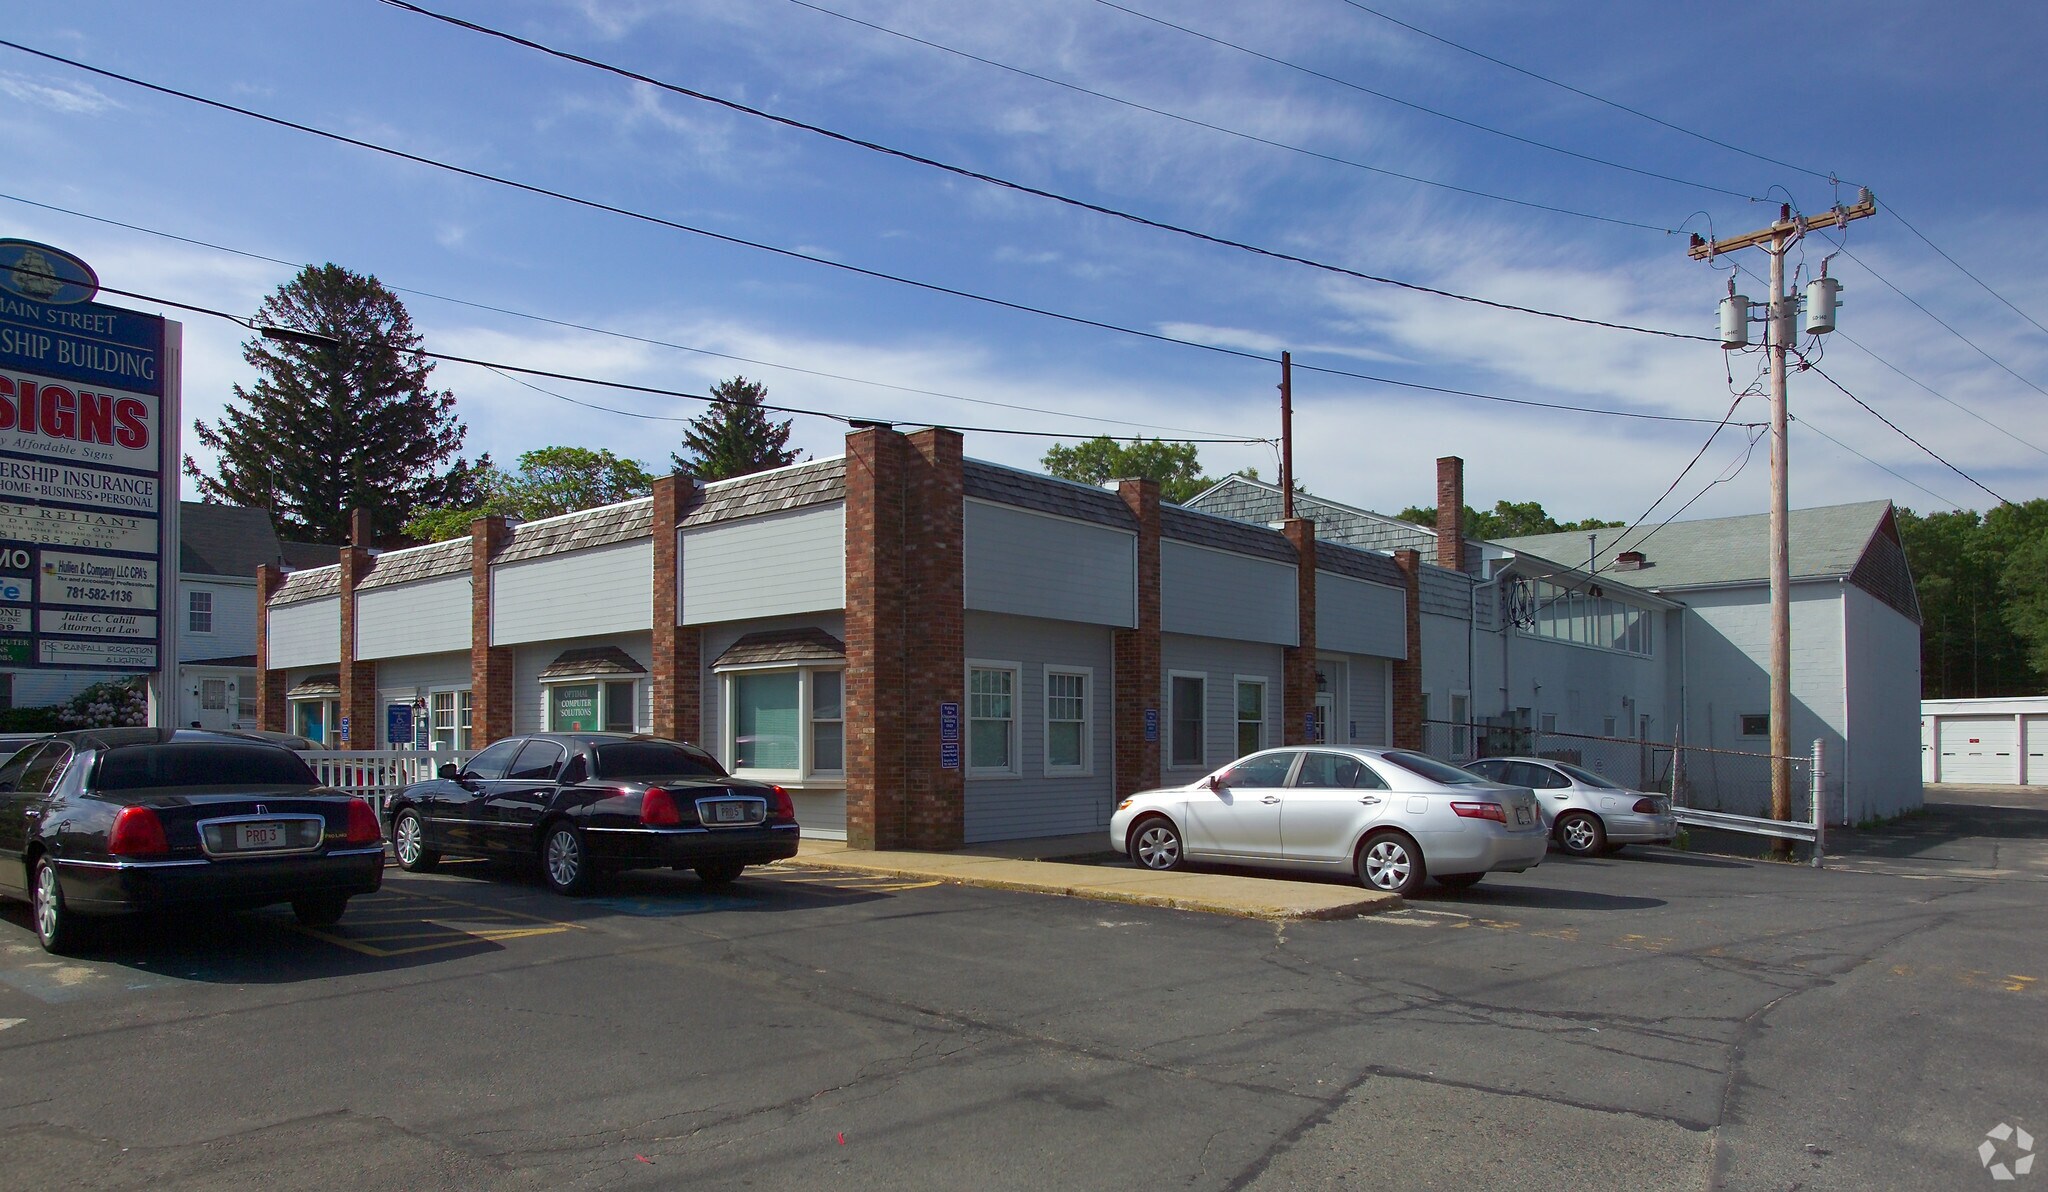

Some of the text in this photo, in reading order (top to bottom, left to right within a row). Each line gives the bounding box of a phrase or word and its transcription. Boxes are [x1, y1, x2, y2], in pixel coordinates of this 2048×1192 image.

[0, 298, 117, 335] AIN STREET
[58, 340, 154, 380] BUILDING
[13, 437, 77, 455] Affordable
[82, 447, 114, 461] Signs
[64, 470, 153, 495] INSURANCE
[41, 484, 93, 500] BUSINESS
[100, 492, 153, 508] PERSONAL
[40, 509, 140, 528] RELIANT
[80, 562, 85, 574] &
[86, 563, 115, 580] Company
[117, 565, 129, 578] LLC
[130, 566, 147, 580] CPA's
[81, 578, 115, 586] Accounting
[116, 580, 155, 588] Professionals
[67, 586, 133, 602] 781-582-1136
[62, 613, 136, 624] Julie C. Cahill
[59, 623, 103, 634] Attorney
[118, 625, 140, 634] Law
[63, 643, 104, 652] RAINFALL
[108, 645, 153, 654] IRRIGATION
[113, 656, 147, 664] LIGHTING
[561, 699, 592, 707] COMPUTER
[560, 708, 592, 717] SOLUTIONS
[246, 829, 276, 842] PRO 3
